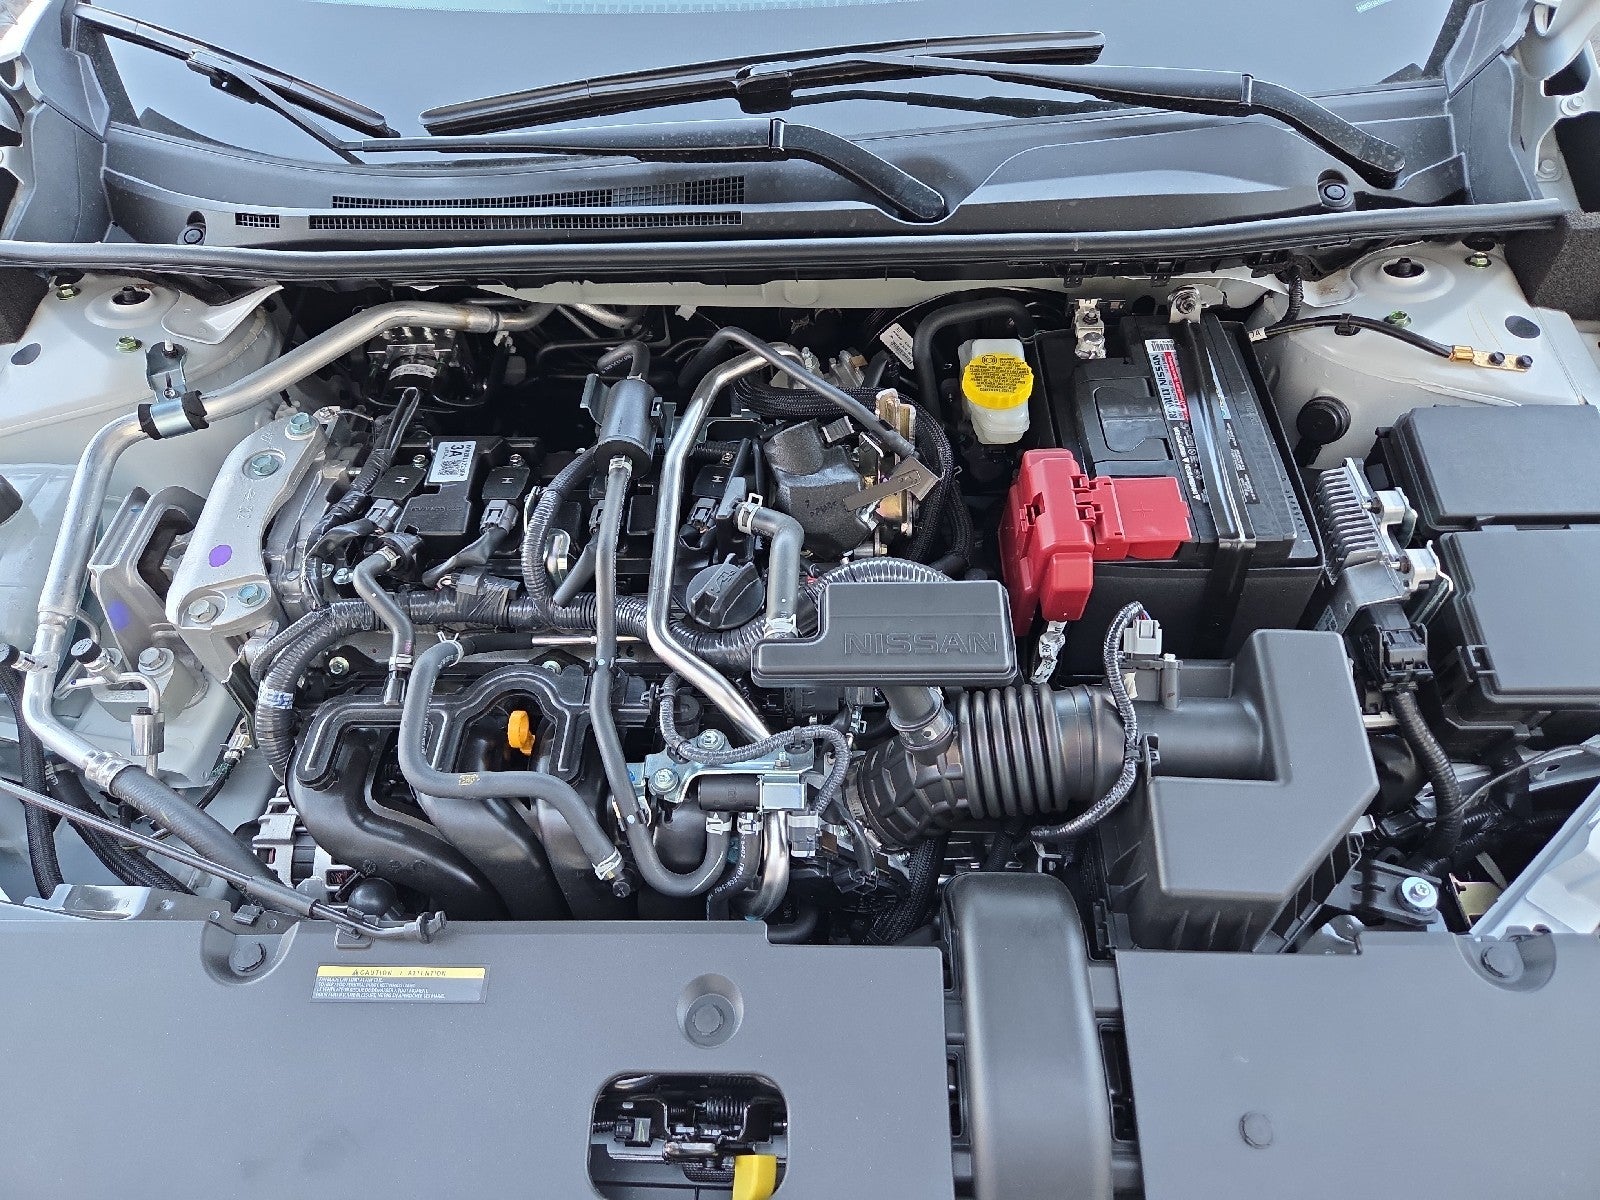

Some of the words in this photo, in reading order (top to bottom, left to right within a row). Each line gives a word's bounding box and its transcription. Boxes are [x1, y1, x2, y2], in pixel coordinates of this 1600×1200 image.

[1152, 354, 1167, 386] NISSAN
[449, 444, 464, 458] 3A
[844, 632, 998, 656] NISSAN
